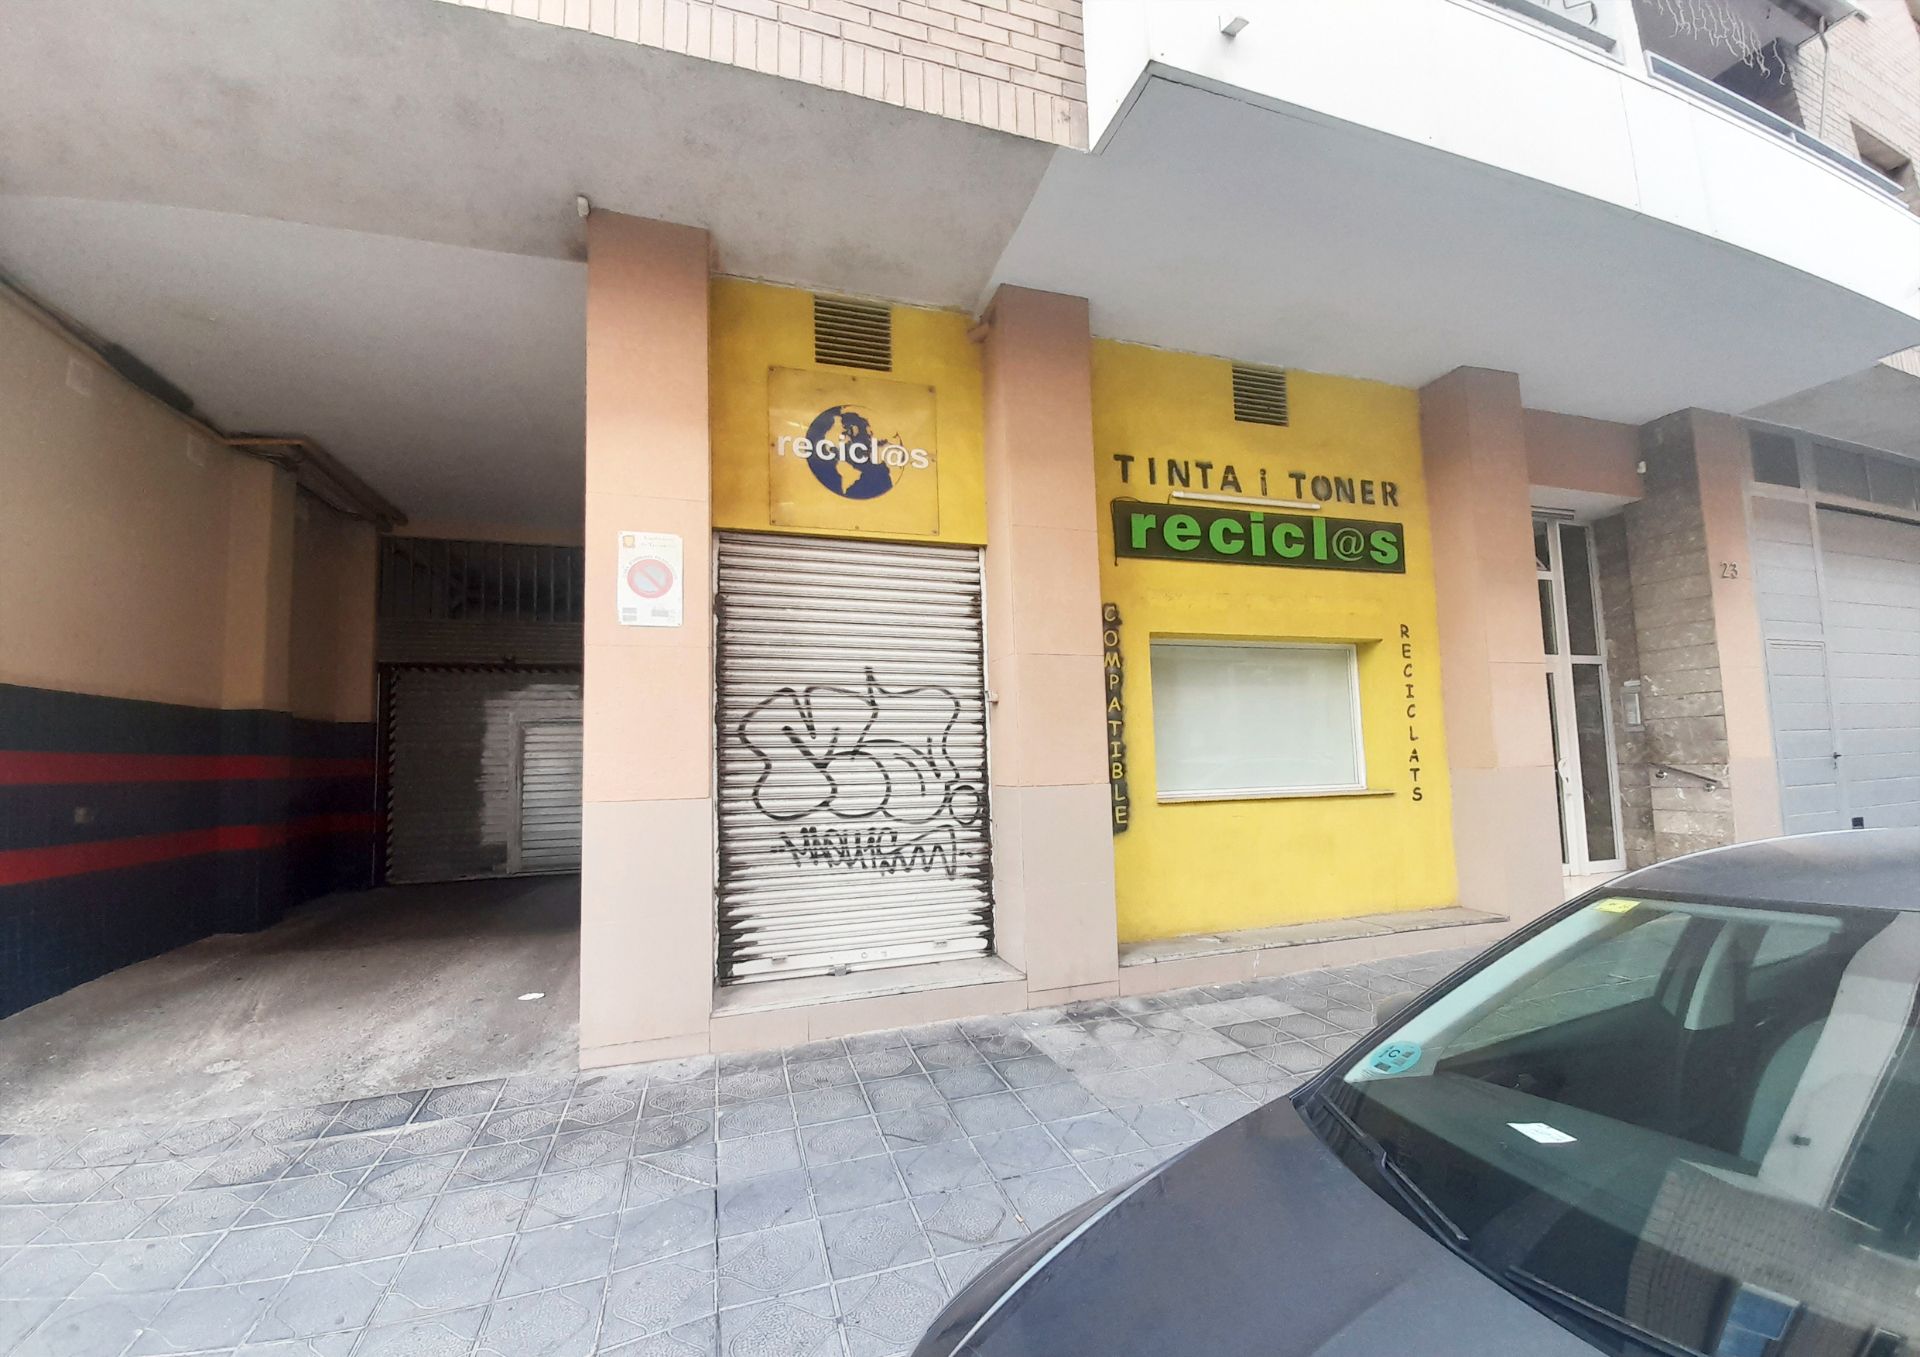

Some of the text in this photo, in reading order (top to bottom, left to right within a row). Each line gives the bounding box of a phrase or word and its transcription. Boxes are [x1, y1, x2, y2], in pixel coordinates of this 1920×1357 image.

[777, 434, 929, 469] recicl@s
[1113, 454, 1242, 493] TINTA
[1288, 471, 1399, 507] TONER
[1131, 511, 1399, 564] recicl@s
[1720, 560, 1738, 579] 23
[1103, 604, 1128, 824] COMPATIBLE
[1400, 624, 1423, 802] RECICLATS
